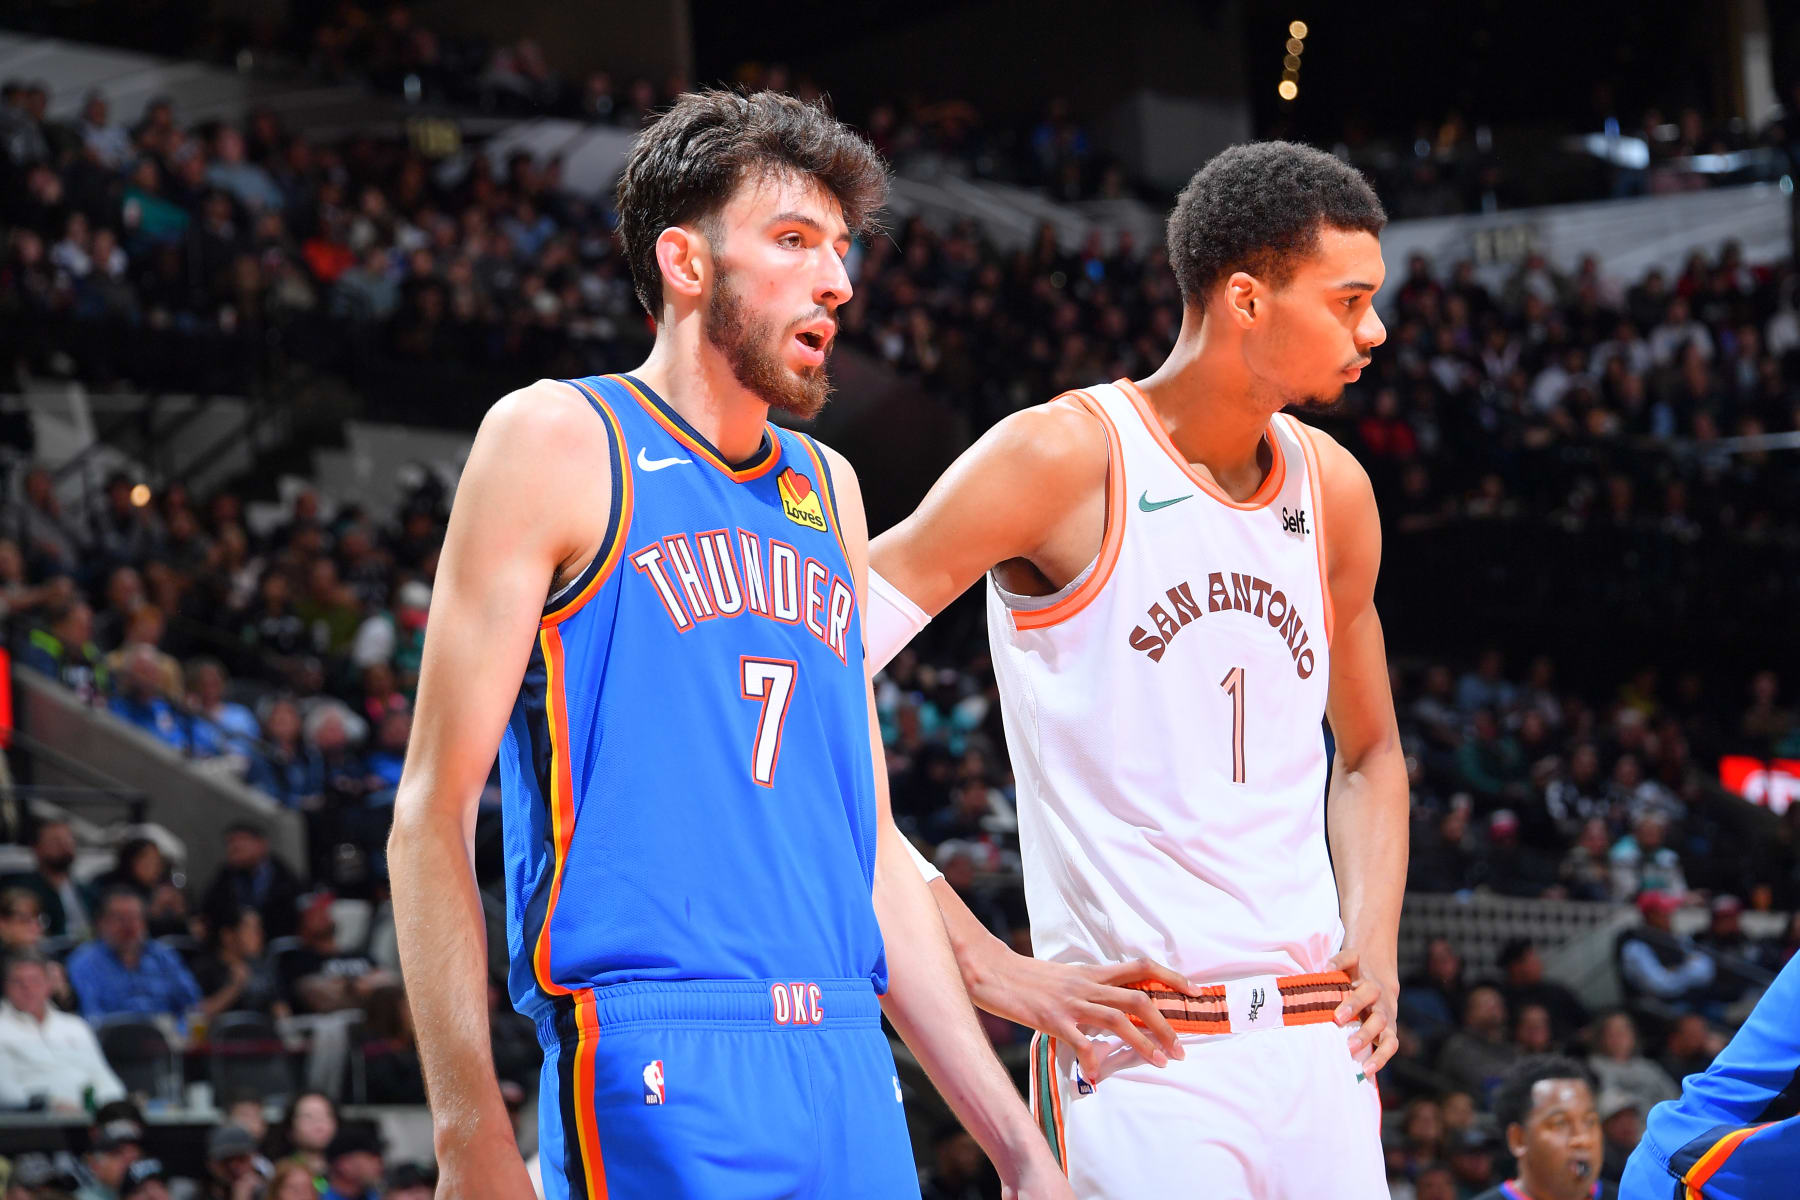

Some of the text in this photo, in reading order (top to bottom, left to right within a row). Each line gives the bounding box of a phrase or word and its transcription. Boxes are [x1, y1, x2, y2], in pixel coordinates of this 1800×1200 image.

[1282, 507, 1310, 535] Self.
[628, 527, 855, 667] THUNDER
[1128, 571, 1315, 680] SAN ANTONIO
[740, 655, 798, 788] 7
[1220, 666, 1246, 784] 1
[771, 982, 824, 1025] OKC
[646, 1094, 658, 1104] NBA
